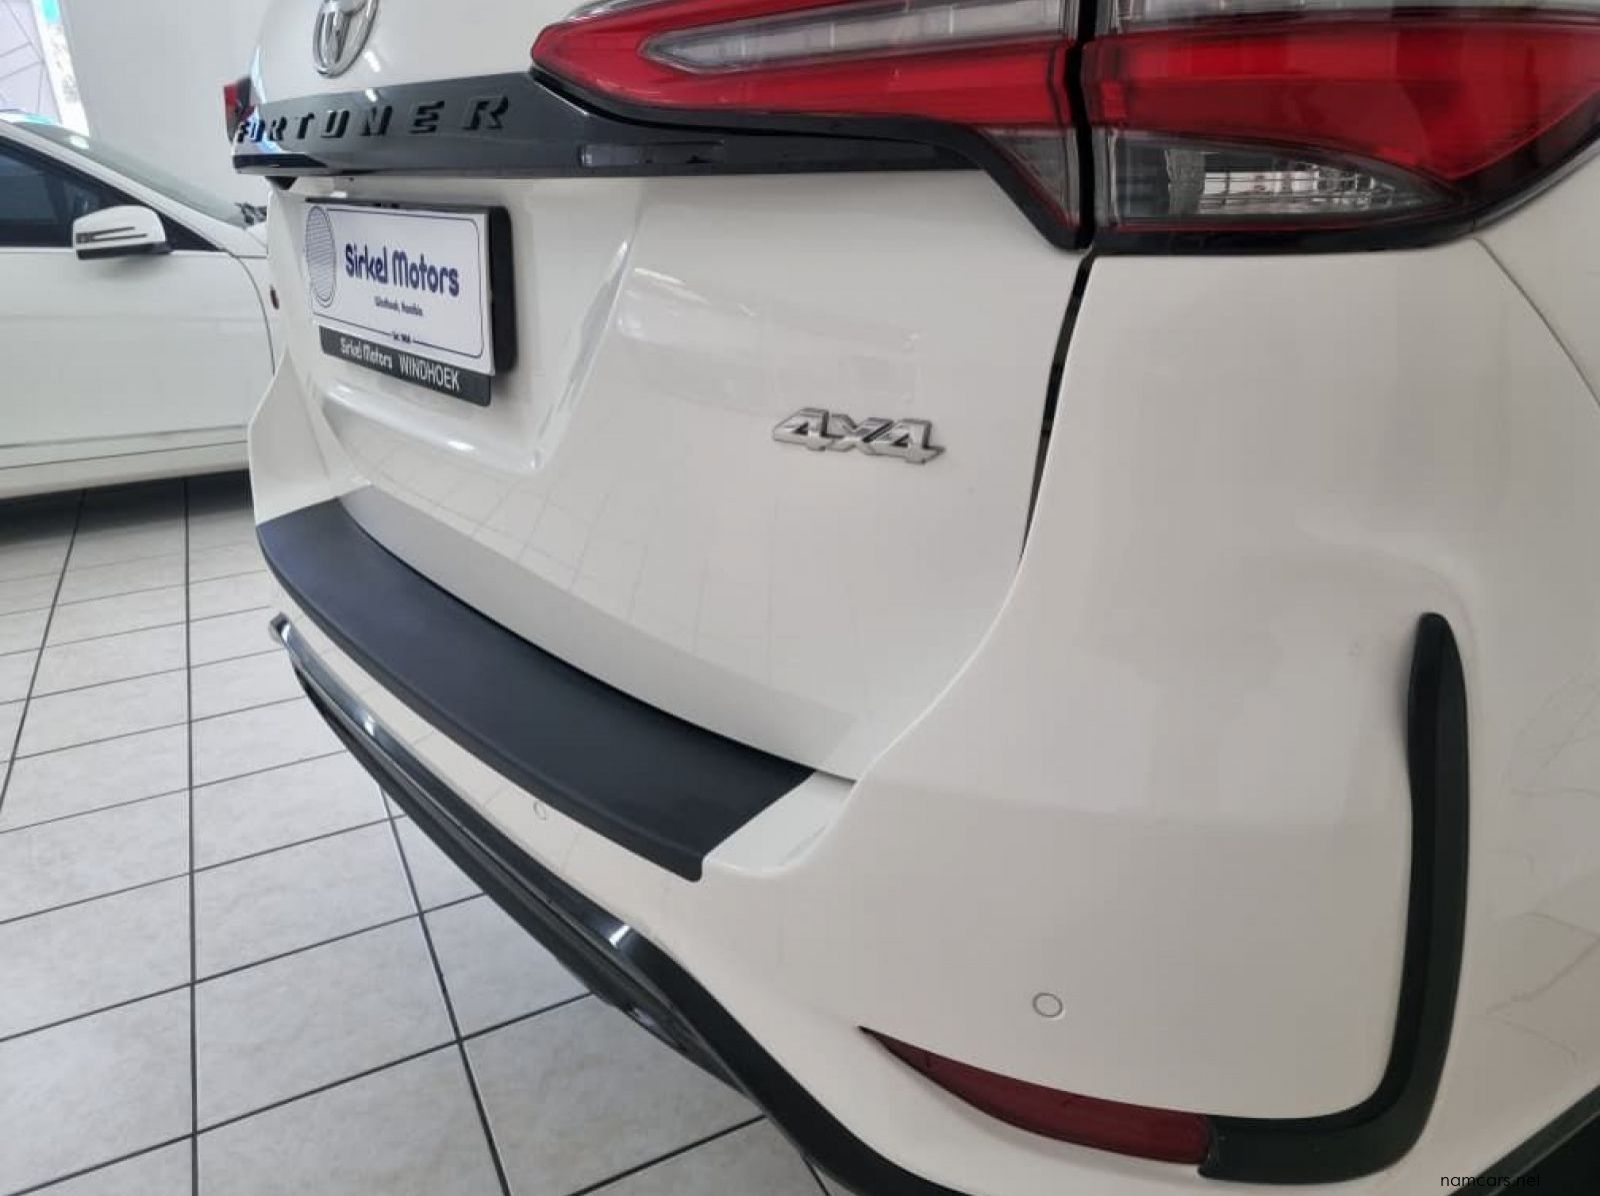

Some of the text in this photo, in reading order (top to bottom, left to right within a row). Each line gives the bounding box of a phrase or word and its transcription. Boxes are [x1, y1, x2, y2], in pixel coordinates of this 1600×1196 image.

[235, 96, 509, 143] FORTUNER
[345, 243, 460, 298] Sirkel Motors
[363, 344, 393, 369] Motors
[400, 355, 460, 391] WINDHOEK
